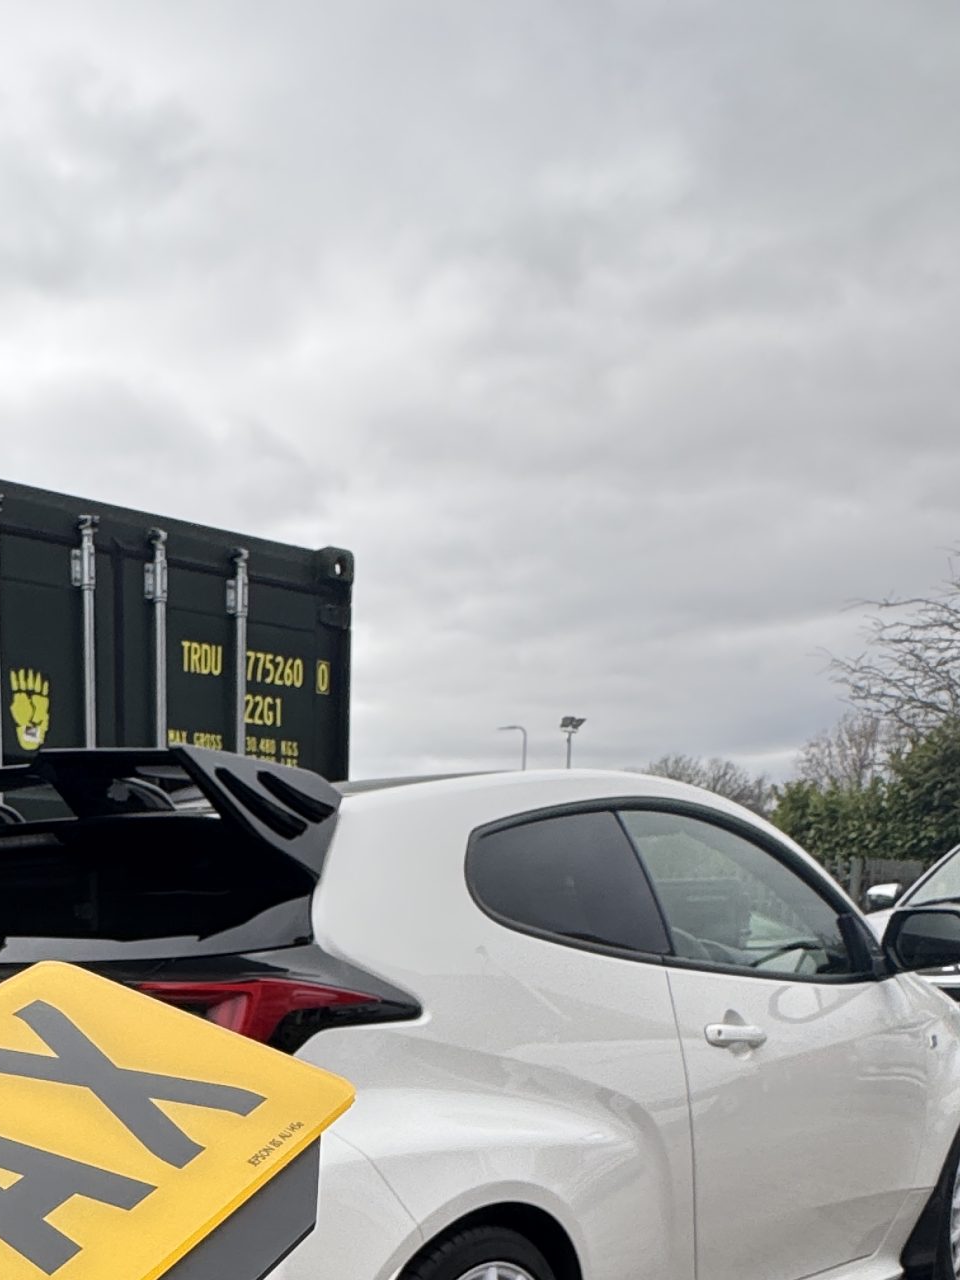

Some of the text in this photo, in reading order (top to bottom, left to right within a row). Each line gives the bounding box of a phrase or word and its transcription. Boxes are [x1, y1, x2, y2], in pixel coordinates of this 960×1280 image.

[181, 640, 329, 692] TRDU 775260 0
[243, 694, 282, 727] 22G1
